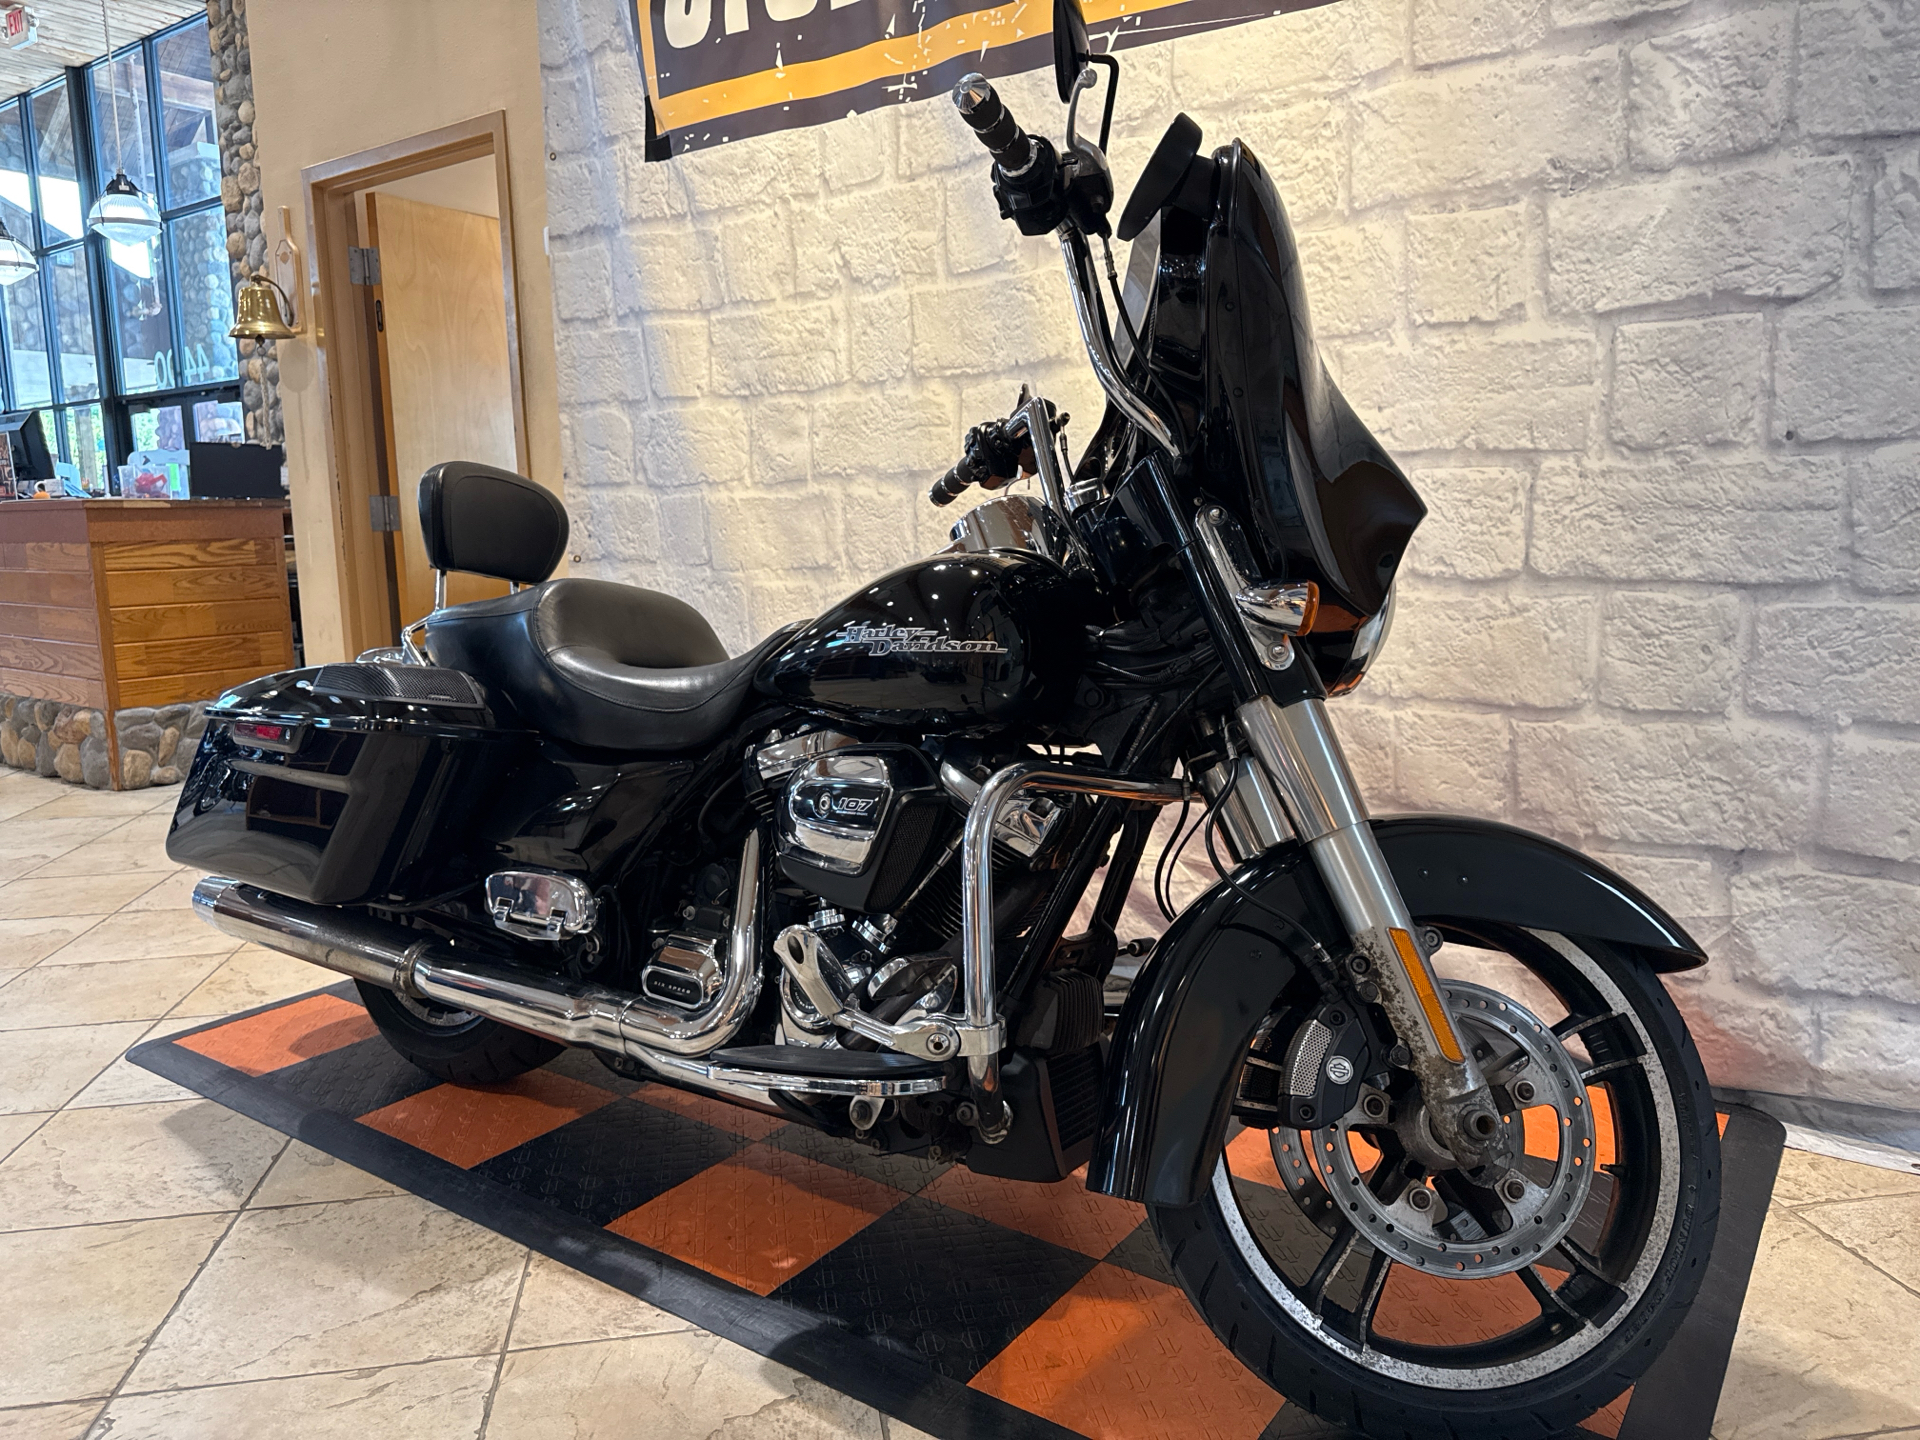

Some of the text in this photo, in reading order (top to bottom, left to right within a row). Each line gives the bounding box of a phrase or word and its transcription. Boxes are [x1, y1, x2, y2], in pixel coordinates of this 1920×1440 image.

[9, 9, 23, 36] EXIT
[837, 624, 938, 643] Harley
[863, 636, 1008, 656] Davidson
[838, 797, 873, 811] 107
[668, 984, 691, 994] SPEED
